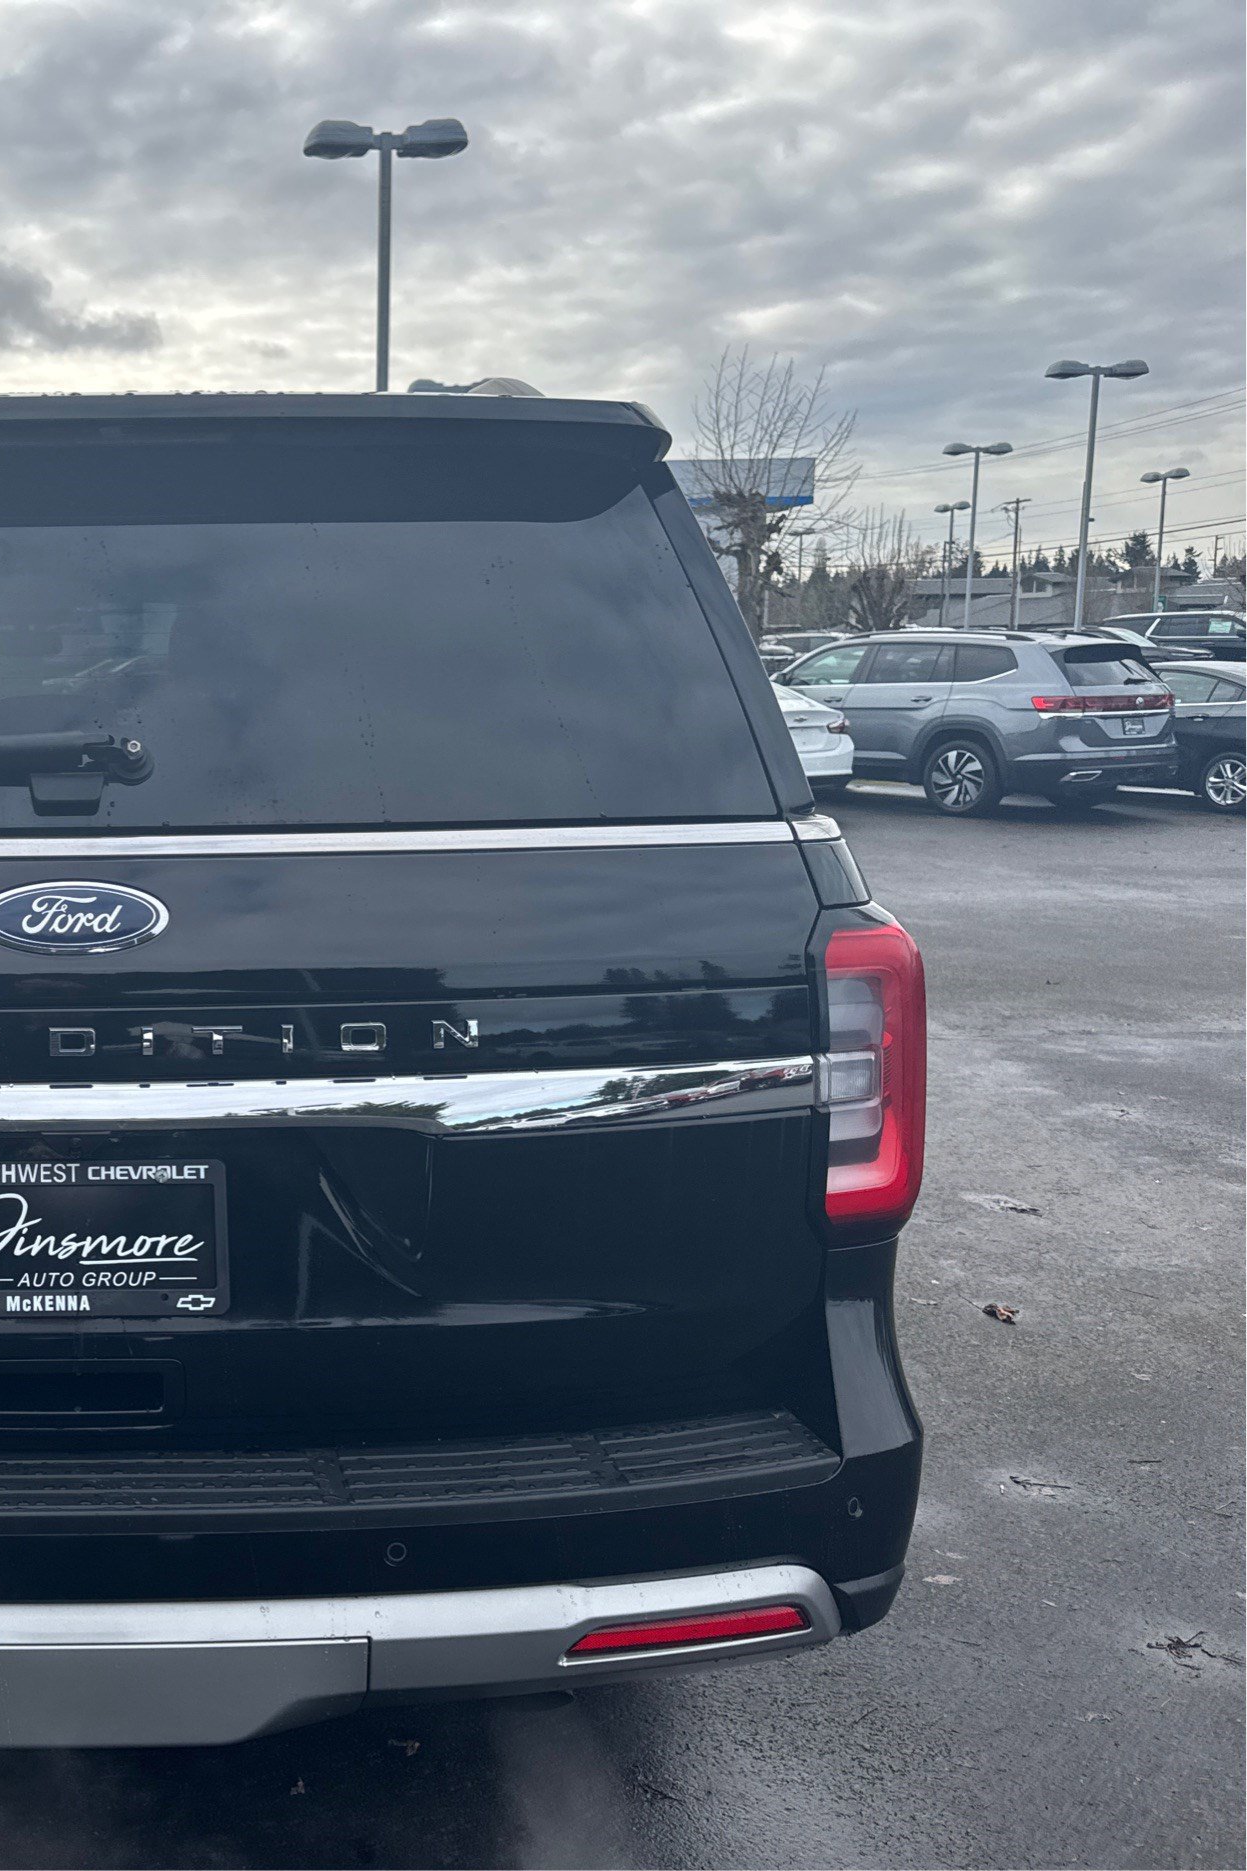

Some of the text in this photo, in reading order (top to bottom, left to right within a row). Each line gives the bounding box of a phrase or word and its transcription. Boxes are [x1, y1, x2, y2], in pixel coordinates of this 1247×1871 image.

[21, 895, 123, 934] Ford
[17, 1271, 157, 1287] AUTO GROUP
[6, 1295, 91, 1312] McKENNA
